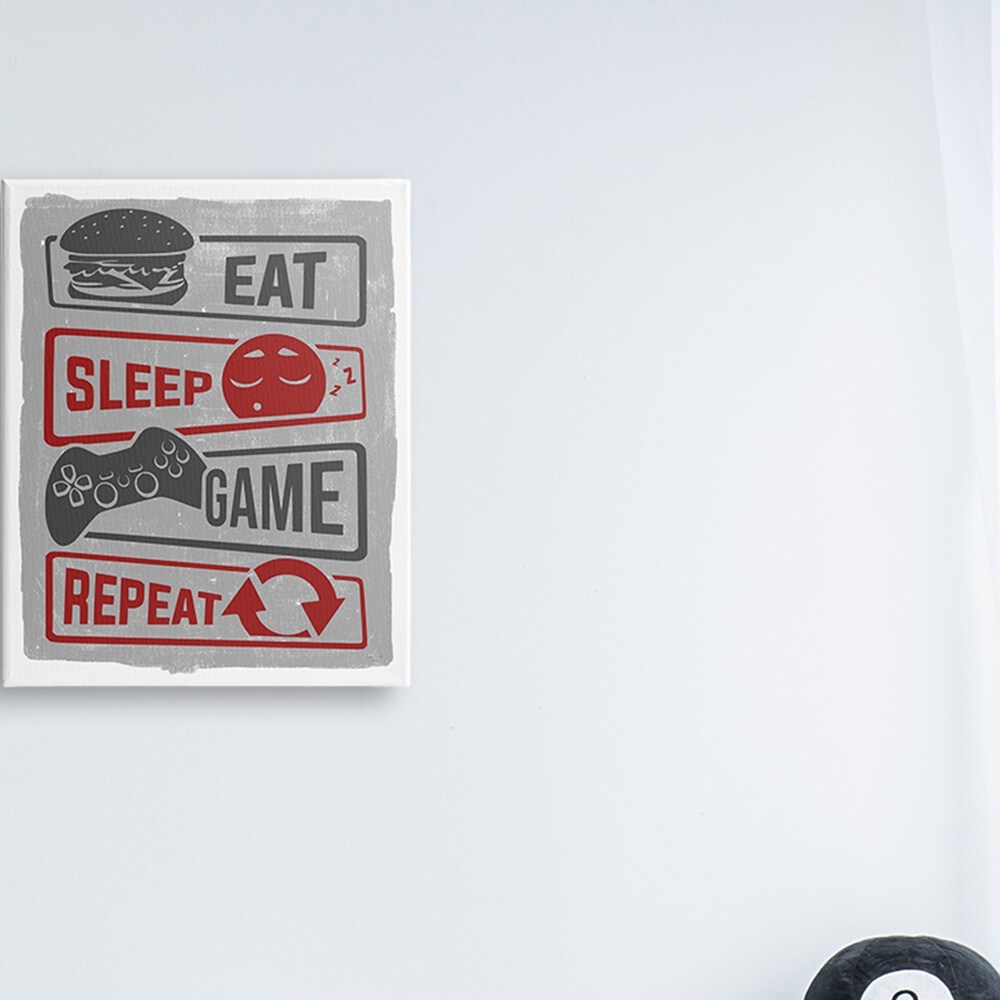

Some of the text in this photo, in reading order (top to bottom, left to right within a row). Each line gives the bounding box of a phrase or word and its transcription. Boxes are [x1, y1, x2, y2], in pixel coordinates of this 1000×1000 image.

[222, 251, 328, 310] EAT
[65, 356, 213, 412] SLEEP
[204, 459, 344, 536] GAME
[62, 567, 223, 626] REPEAT
